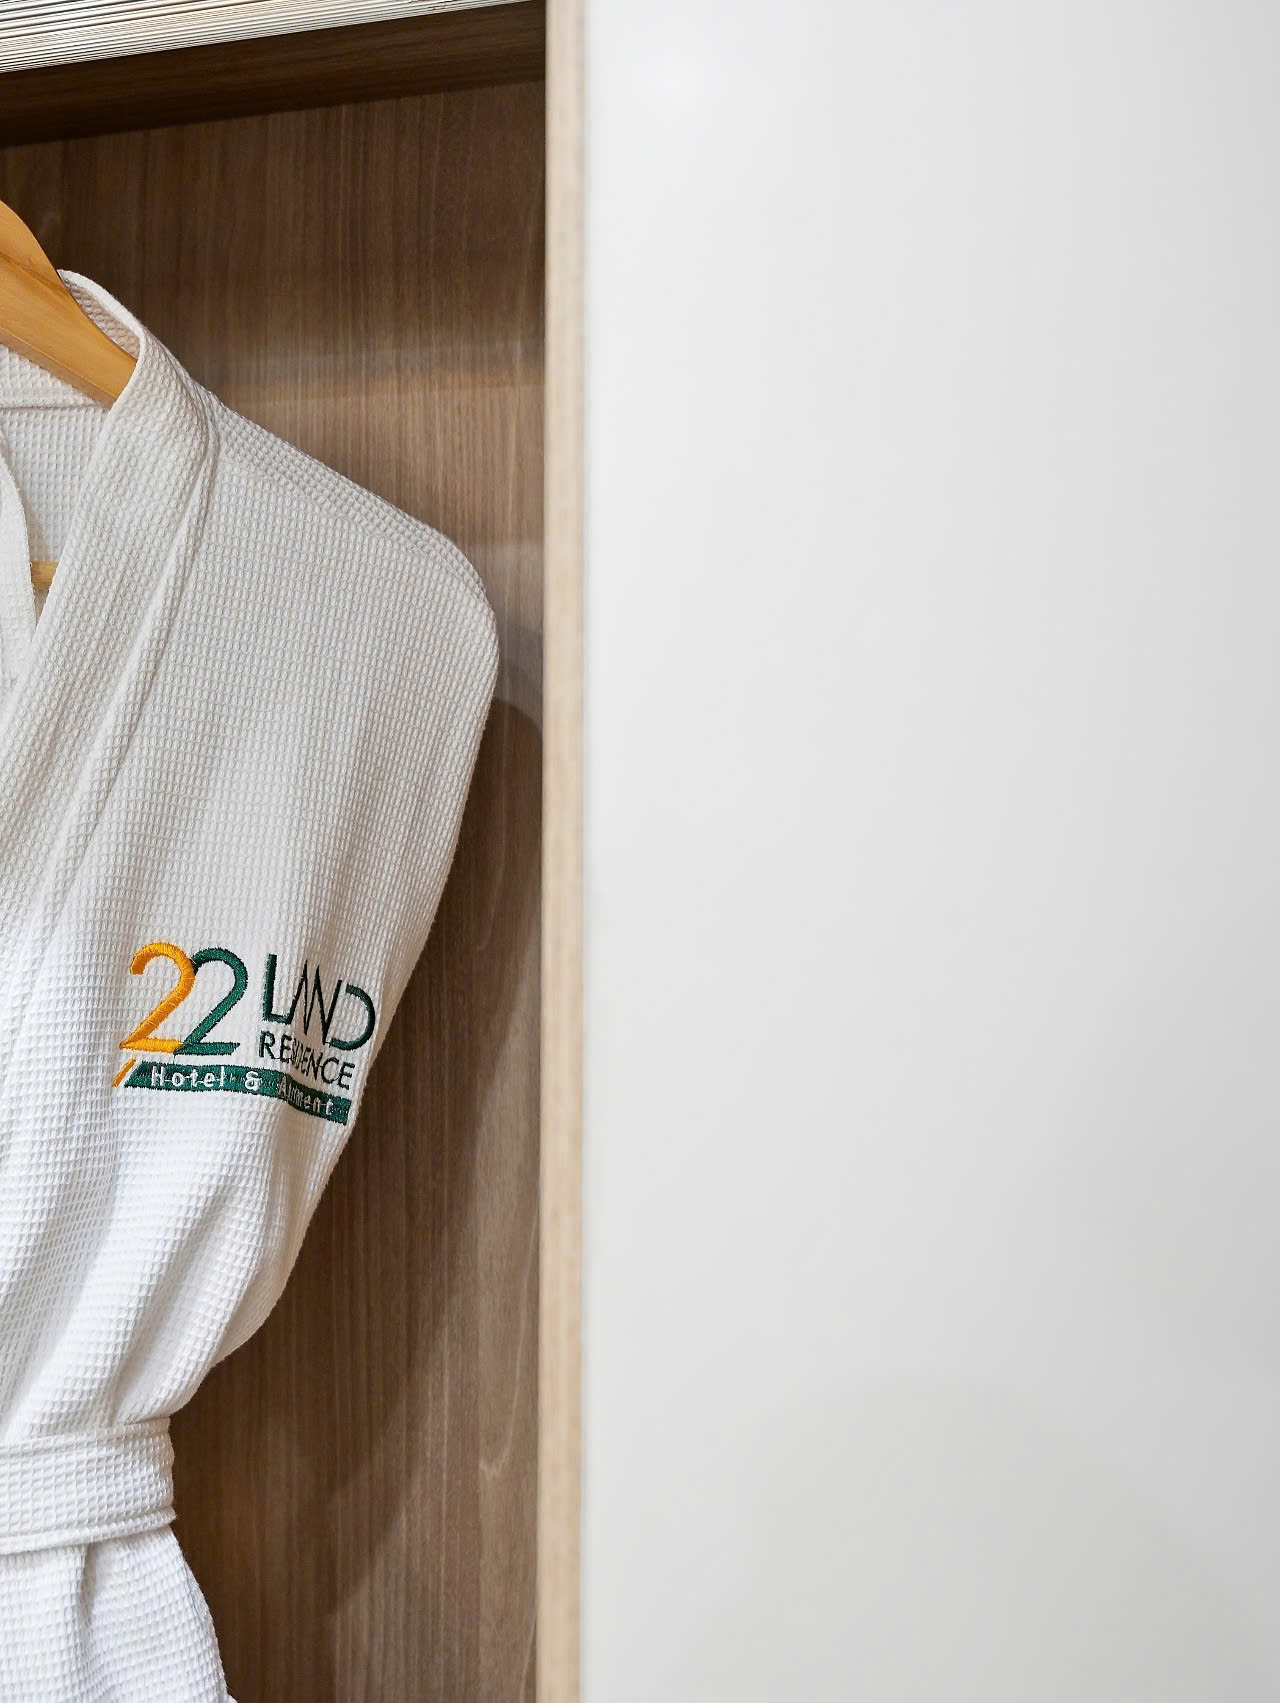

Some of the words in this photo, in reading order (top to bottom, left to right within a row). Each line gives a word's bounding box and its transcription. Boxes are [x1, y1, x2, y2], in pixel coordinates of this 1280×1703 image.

[119, 941, 249, 1056] 22
[262, 953, 376, 1052] LAND
[150, 1065, 225, 1088] Hotel
[244, 1070, 263, 1092] &
